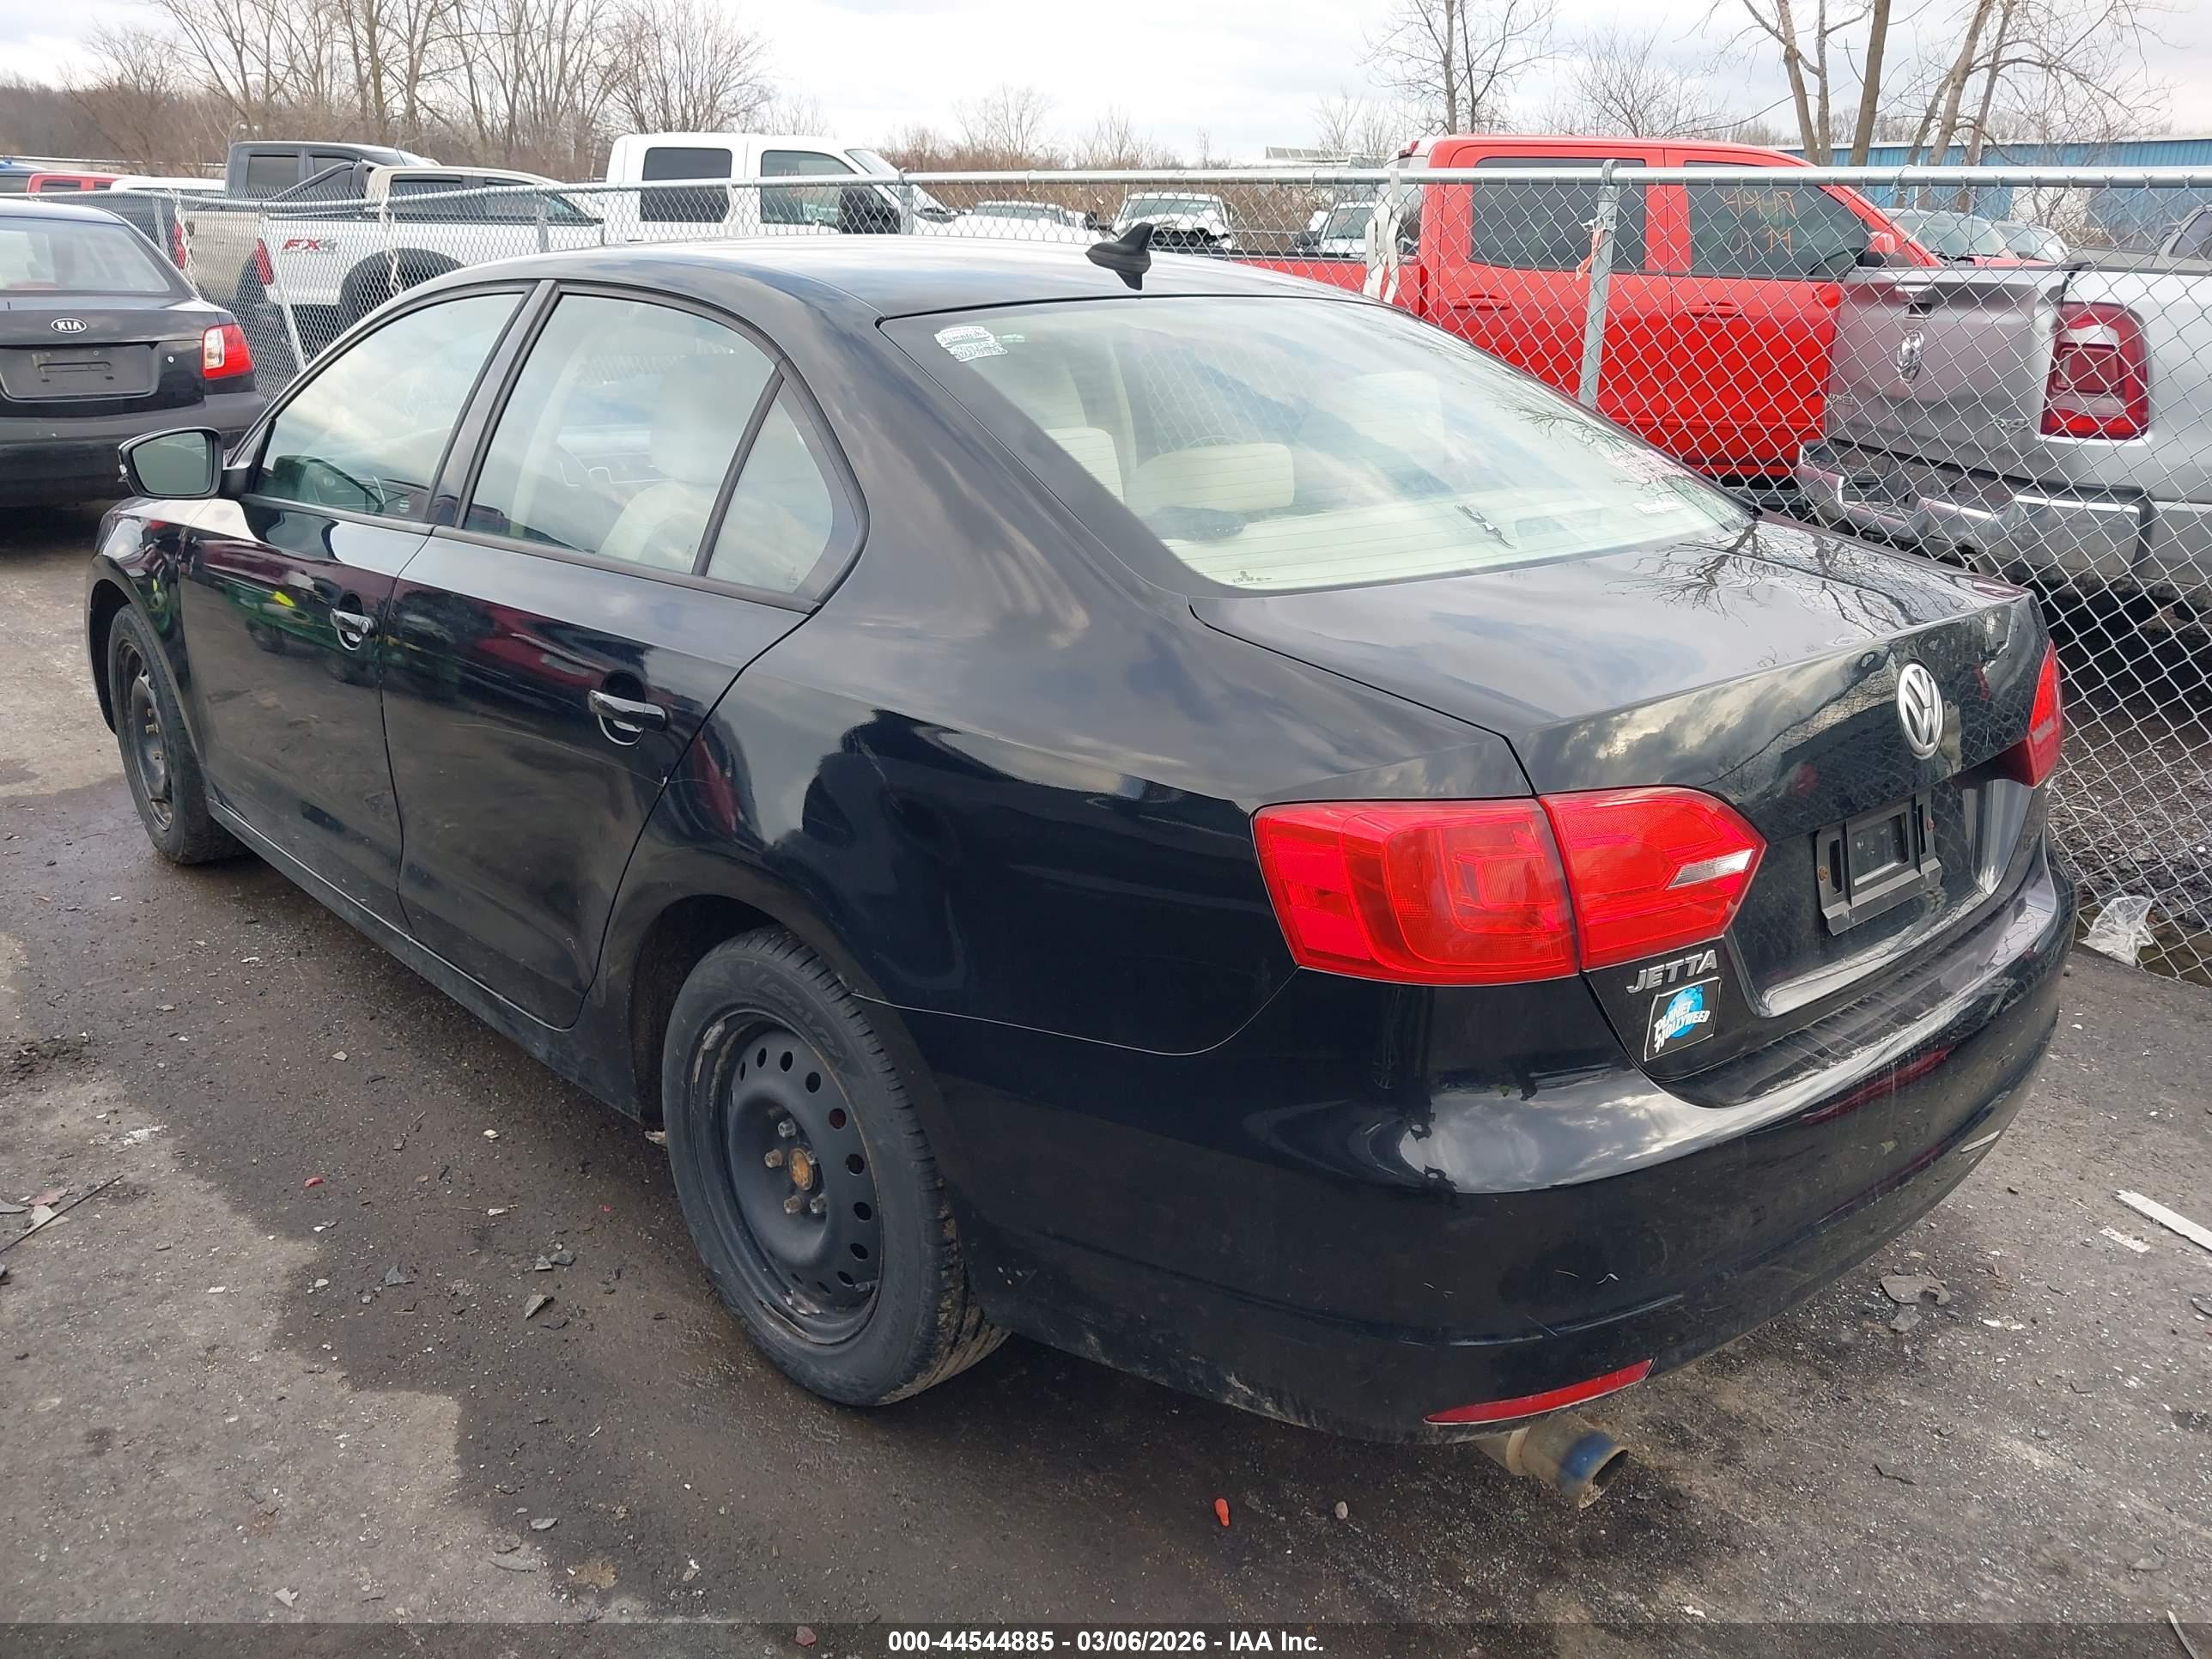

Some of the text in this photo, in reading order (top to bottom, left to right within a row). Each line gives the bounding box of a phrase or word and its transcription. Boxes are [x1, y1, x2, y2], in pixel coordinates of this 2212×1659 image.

[1626, 949, 1717, 994] JETTA
[1653, 1000, 1694, 1042] PLANET
[1653, 1010, 1711, 1054] HOLLYWEED
